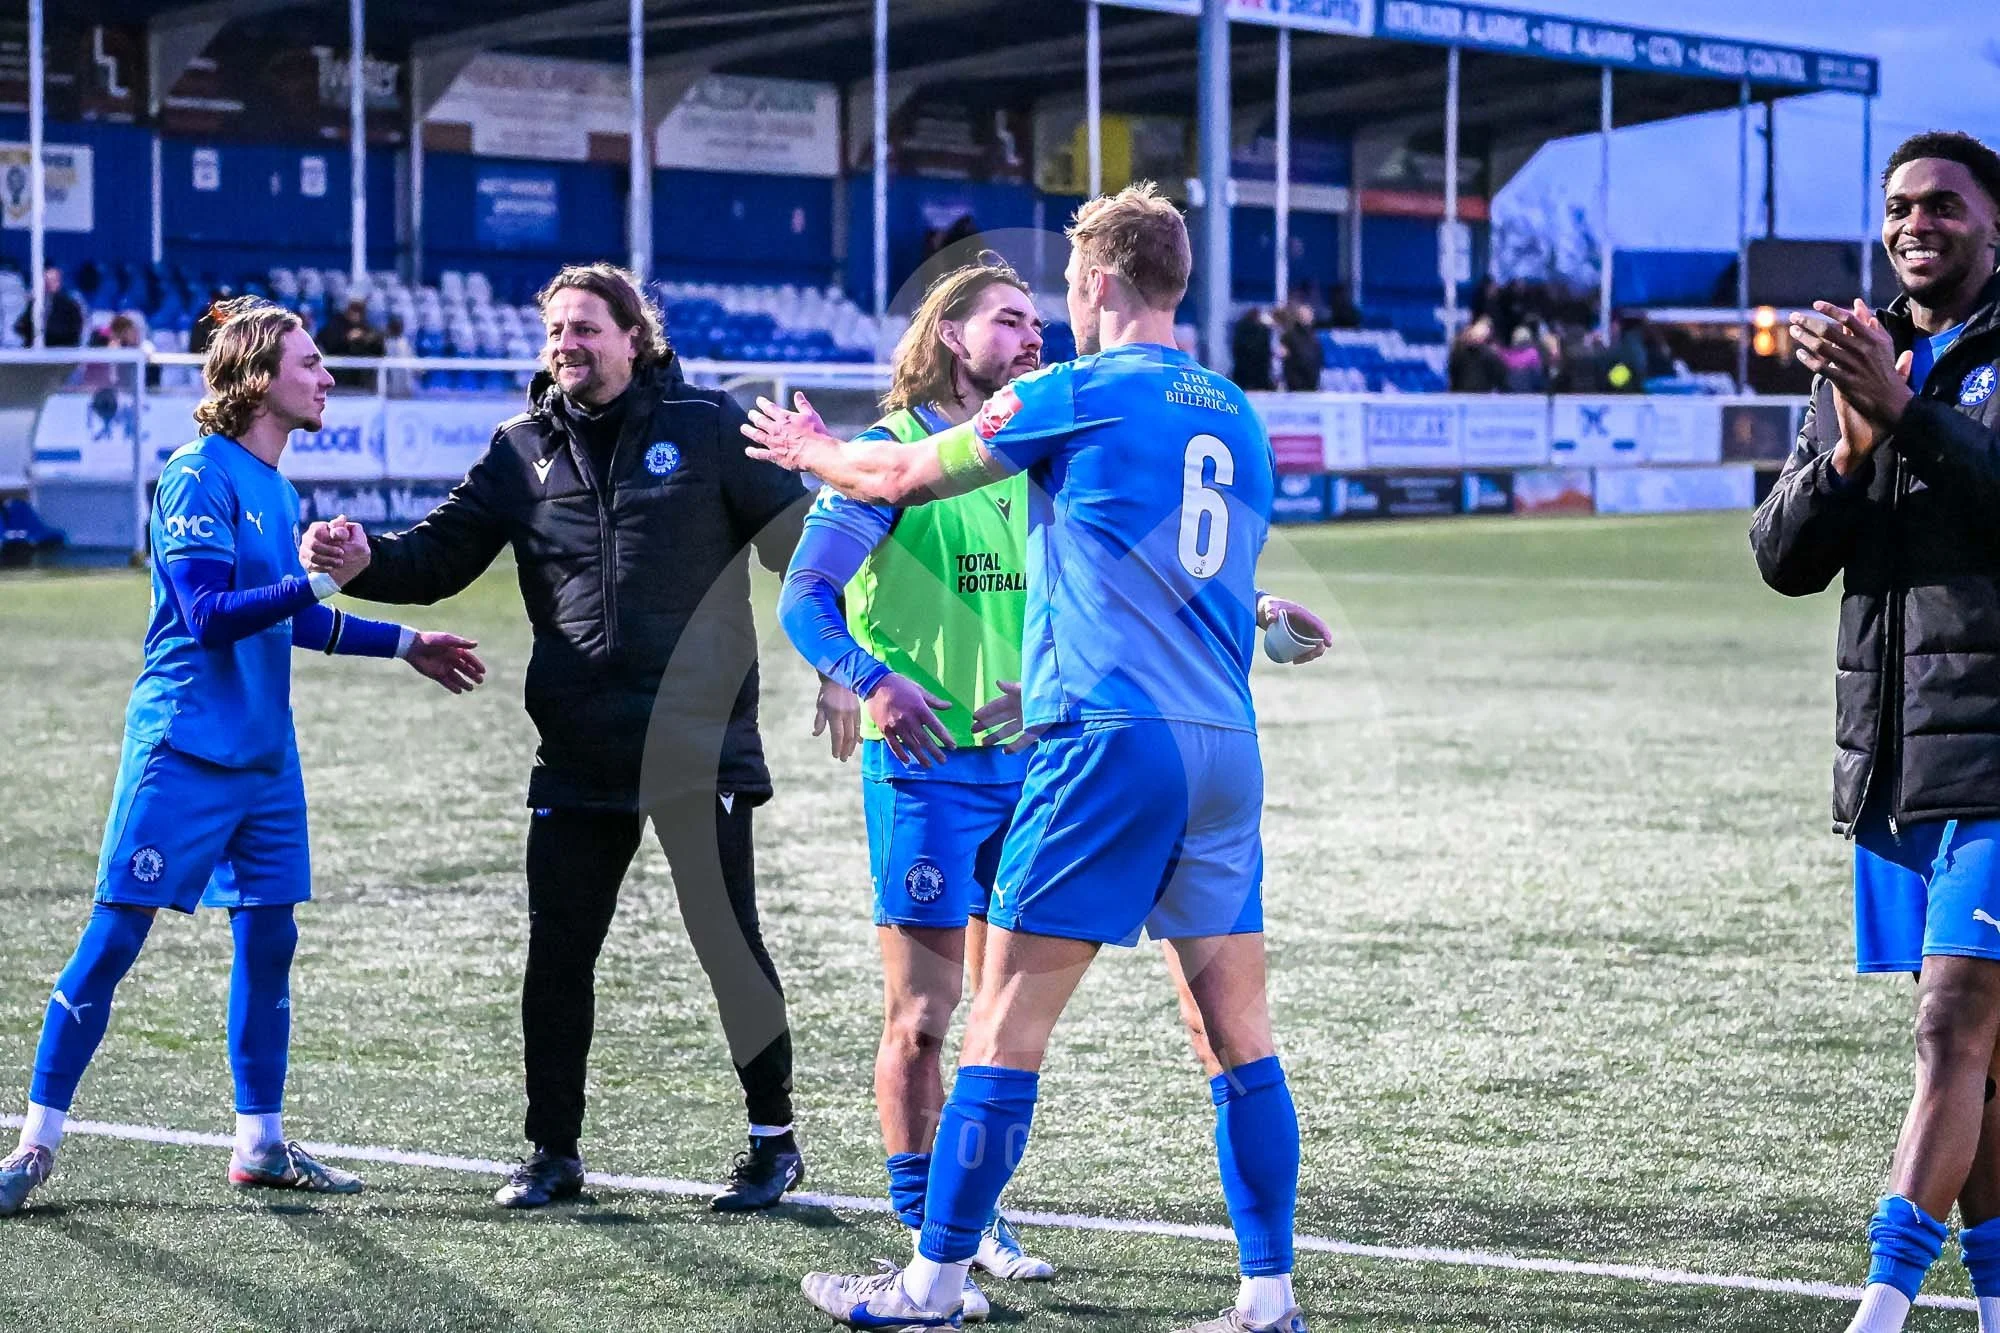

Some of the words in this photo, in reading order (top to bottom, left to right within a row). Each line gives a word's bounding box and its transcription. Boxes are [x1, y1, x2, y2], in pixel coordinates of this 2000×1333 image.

[1179, 371, 1212, 387] THE
[1172, 381, 1227, 401] CROWN
[1164, 390, 1240, 415] BILLERICAY
[1177, 433, 1234, 579] 6
[955, 552, 1001, 573] TOTAL
